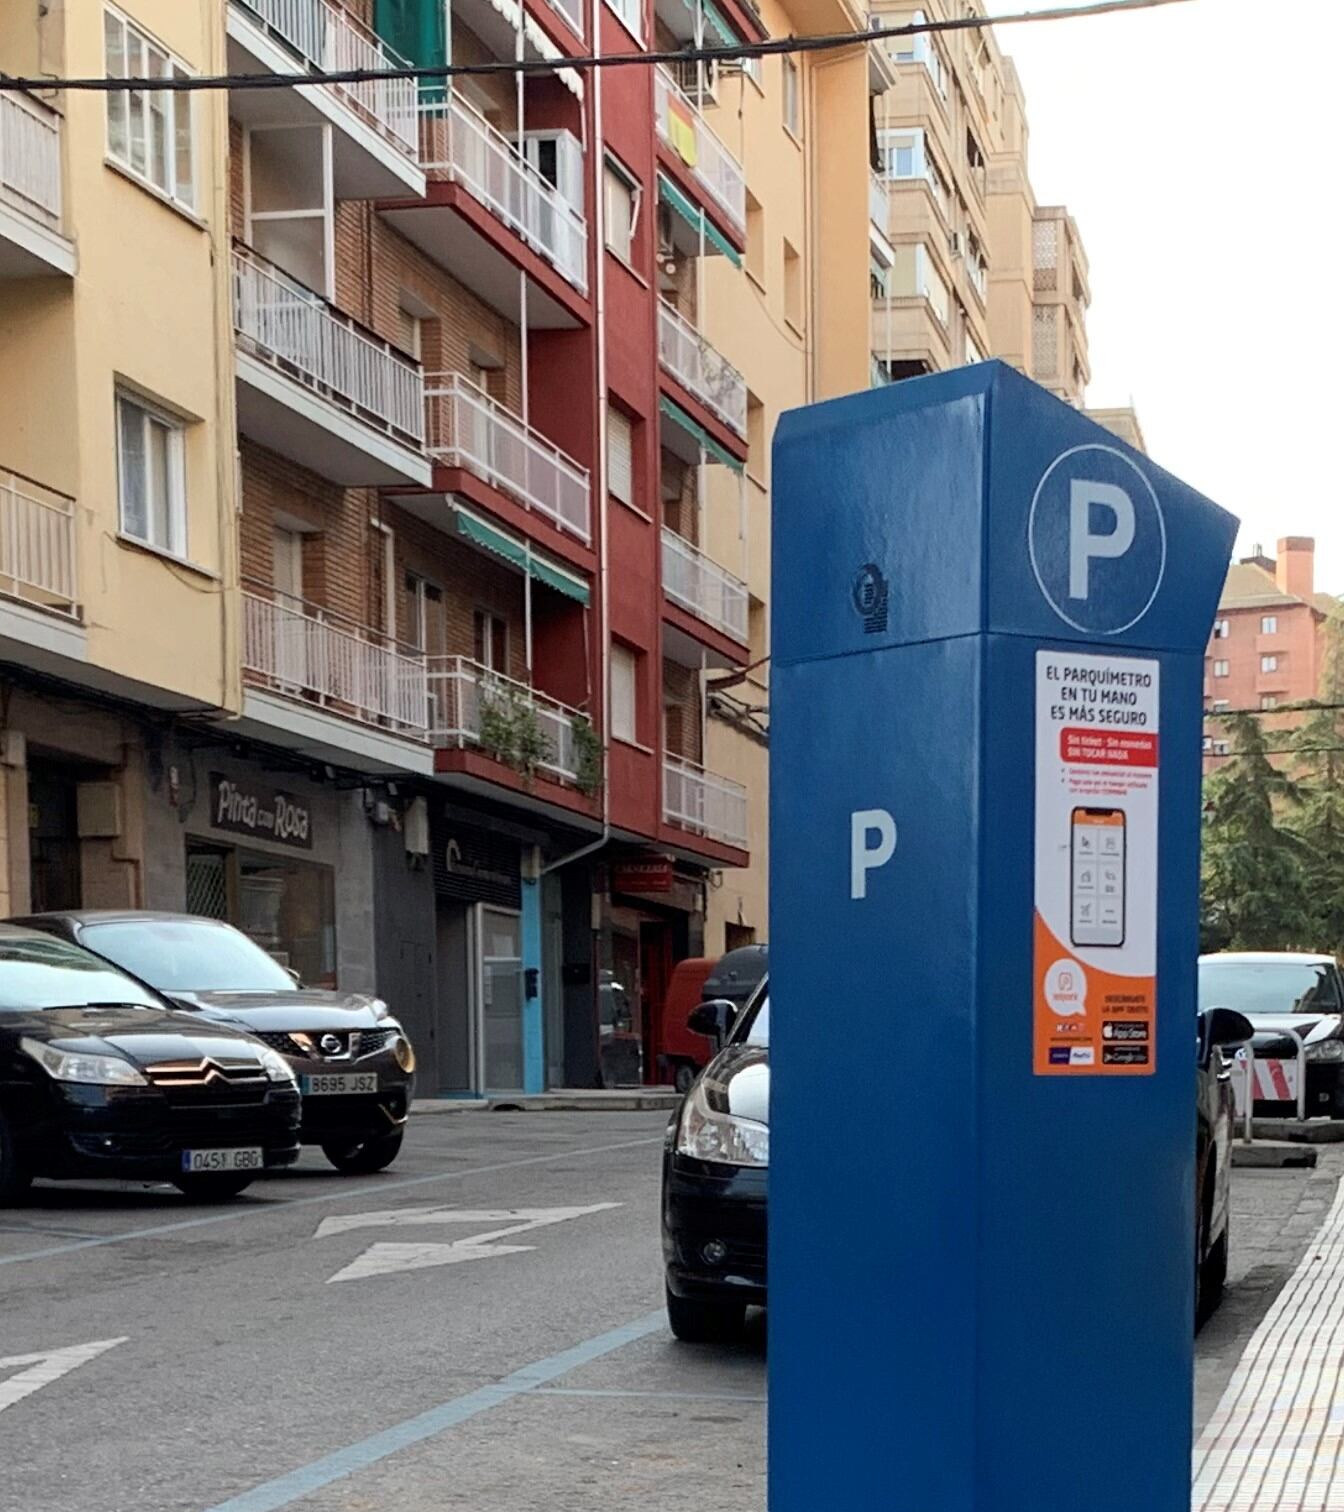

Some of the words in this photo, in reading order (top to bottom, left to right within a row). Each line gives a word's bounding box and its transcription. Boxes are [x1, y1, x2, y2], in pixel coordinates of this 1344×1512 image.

[1069, 479, 1136, 599] P
[1046, 666, 1060, 681] EL
[1064, 667, 1151, 688] PARQUÍMETRO
[1061, 686, 1077, 701] EN
[1081, 688, 1097, 703] TU
[1101, 690, 1137, 706] MANO
[1050, 705, 1065, 720] ES
[1069, 704, 1095, 722] MÁS
[1099, 708, 1147, 726] SEGURO
[217, 780, 257, 829] Pinta
[274, 795, 308, 840] Rosa
[850, 808, 898, 900] P
